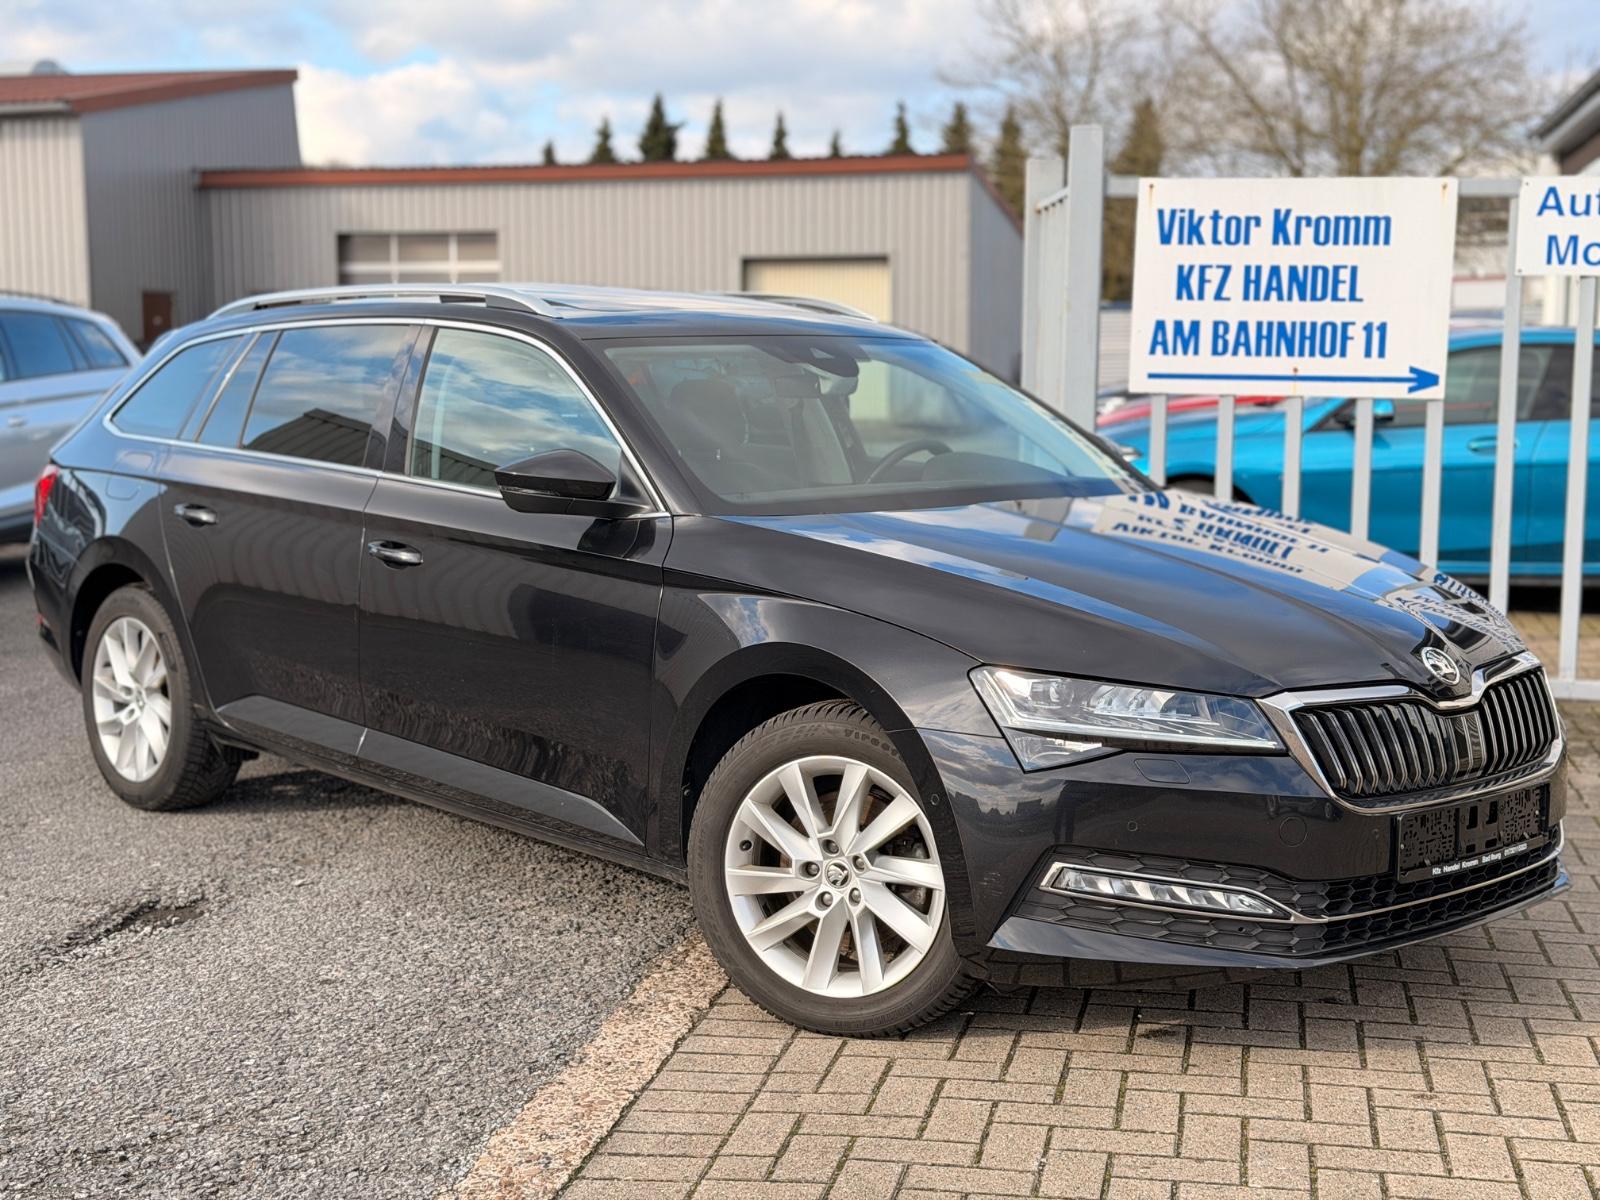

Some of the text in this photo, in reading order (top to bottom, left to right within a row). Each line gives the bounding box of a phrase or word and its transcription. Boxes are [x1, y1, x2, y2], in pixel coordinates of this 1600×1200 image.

[1157, 207, 1392, 247] Viktor Kromm
[1545, 234, 1600, 267] Mo
[1175, 263, 1363, 303] KFZ HANDEL
[1148, 319, 1388, 360] AM BAHNHOF 11
